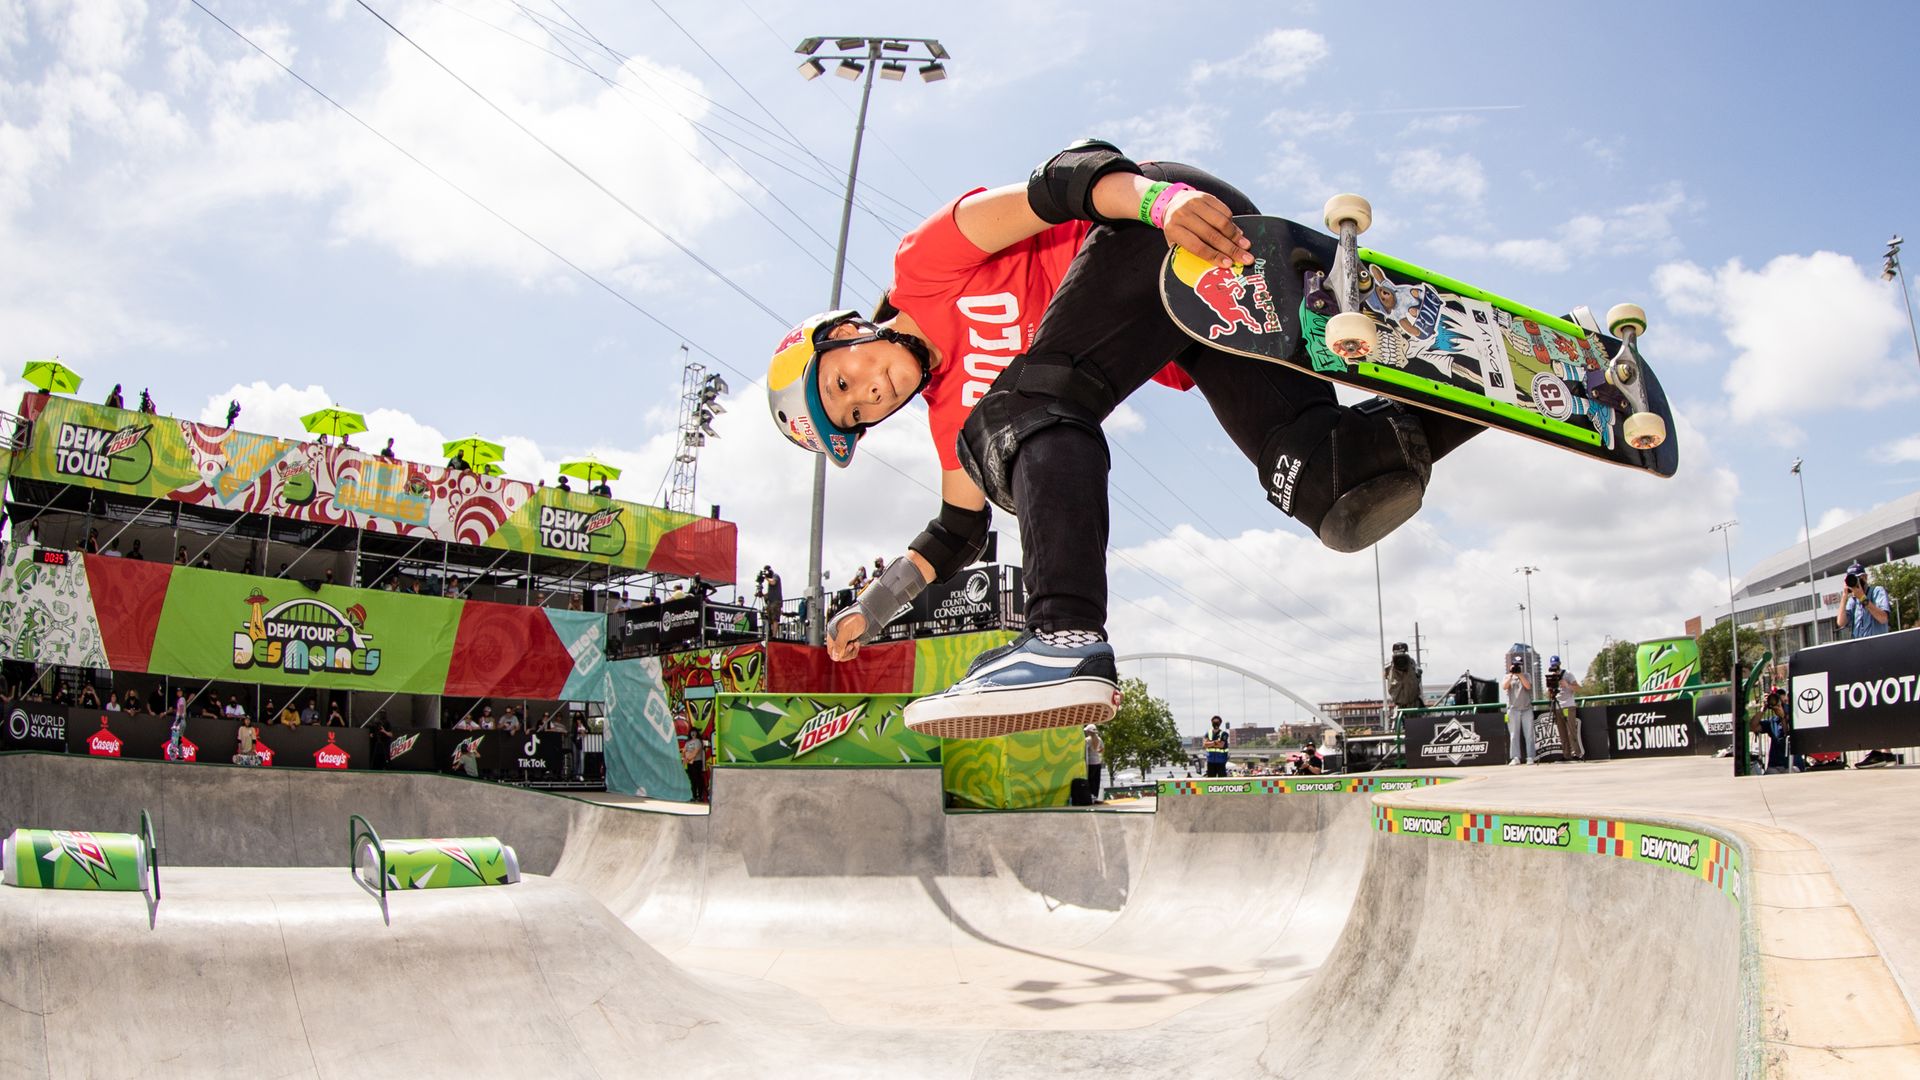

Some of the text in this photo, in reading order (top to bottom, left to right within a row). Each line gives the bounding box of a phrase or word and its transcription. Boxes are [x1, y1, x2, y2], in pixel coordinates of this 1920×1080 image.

[1246, 274, 1283, 333] Red Bull
[1540, 384, 1564, 411] 13
[60, 424, 112, 453] DEW
[58, 449, 110, 479] TOUR
[1271, 455, 1290, 503] 187
[1282, 459, 1301, 512] KILLER PADS
[541, 506, 588, 529] DEW
[540, 527, 590, 552] TOUR
[934, 602, 991, 619] CONSERVATION
[942, 598, 966, 608] COUNTY
[671, 609, 699, 622] GreenState
[714, 611, 734, 622] DEW
[234, 632, 380, 671] DES MOINES
[30, 713, 65, 727] WORLD
[1616, 712, 1666, 727] CATCH
[30, 725, 66, 740] SKATE
[1617, 724, 1688, 750] DES MOINES
[92, 737, 120, 753] Casey's
[1424, 744, 1485, 754] PRAIRIE MEADOWS
[318, 751, 346, 766] Casey's
[517, 758, 547, 769] TikTok
